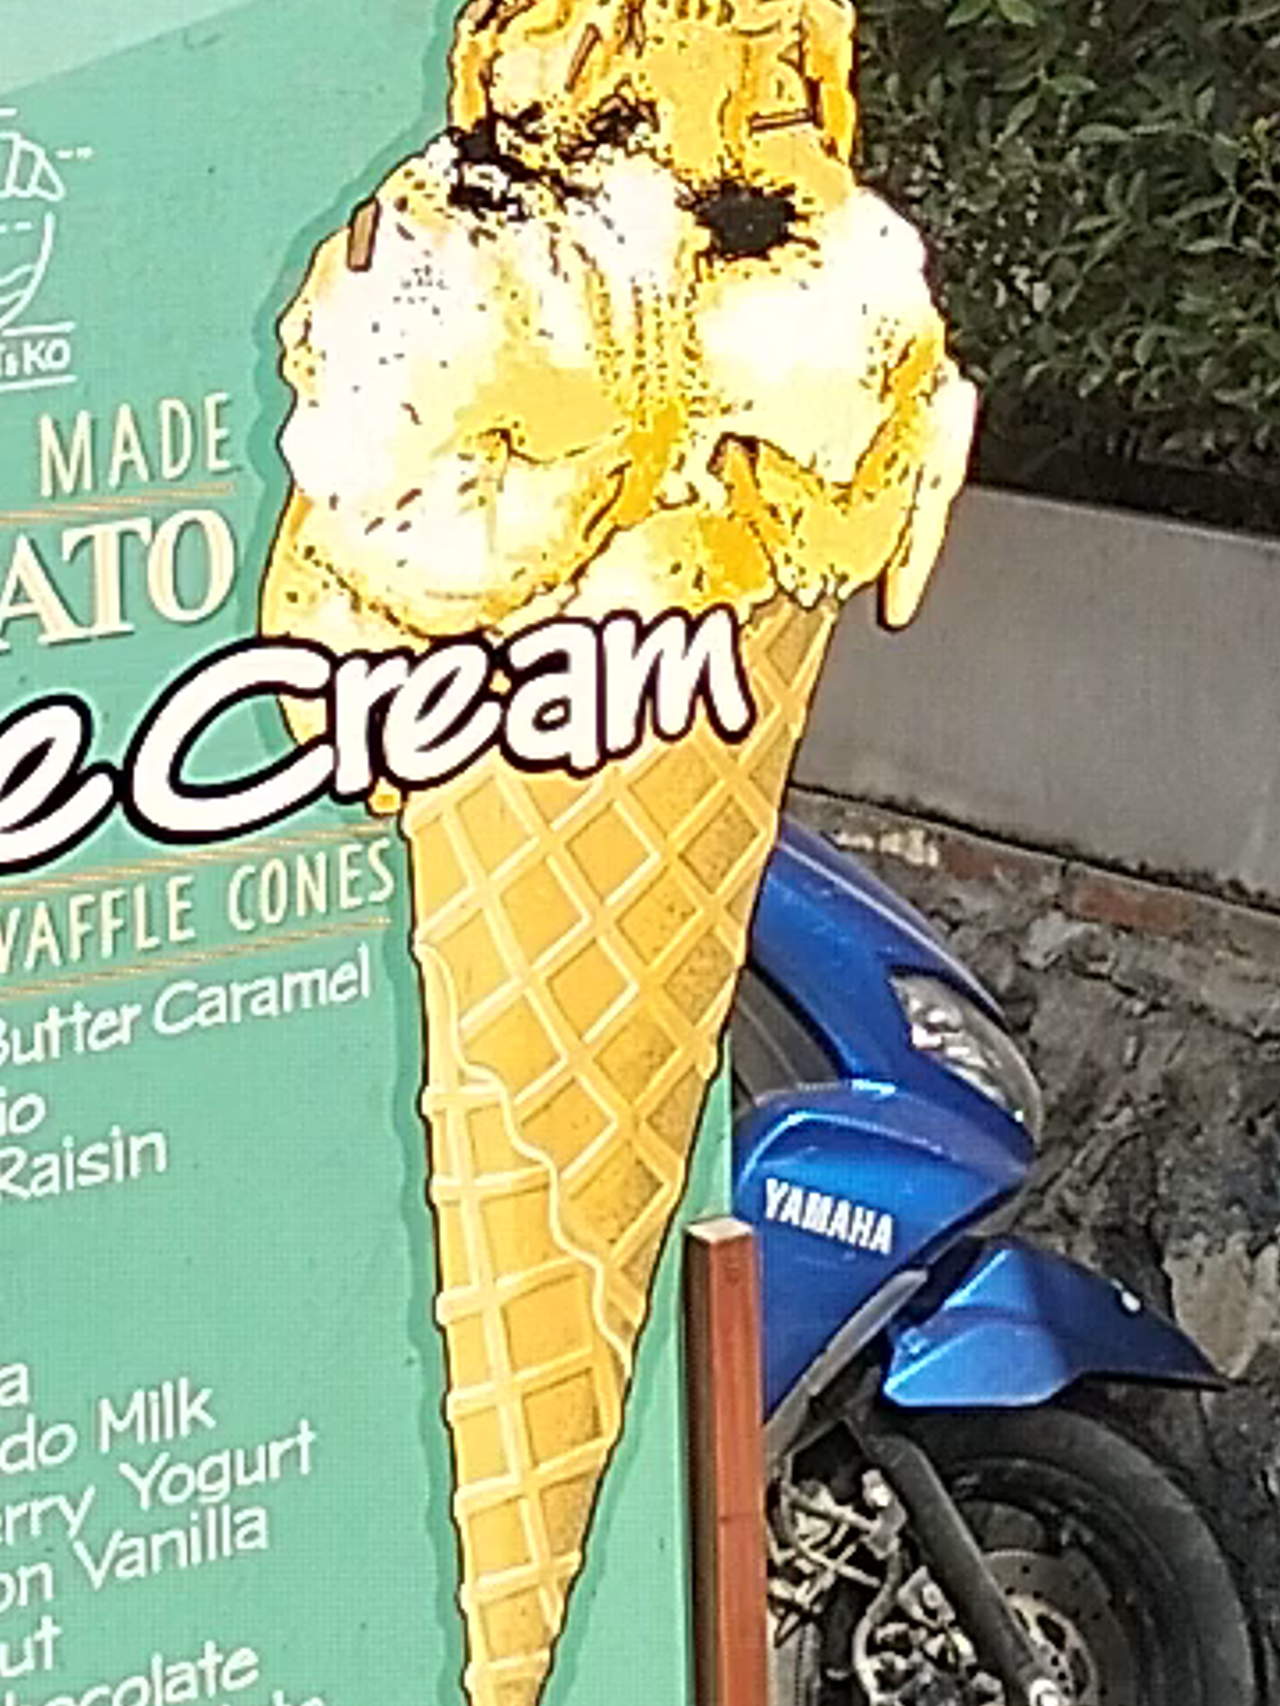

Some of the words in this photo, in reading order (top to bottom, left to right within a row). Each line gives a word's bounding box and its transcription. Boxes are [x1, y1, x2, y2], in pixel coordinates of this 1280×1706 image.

[39, 392, 233, 497] MADE
[124, 604, 756, 845] Cream
[228, 838, 397, 932] CONES
[153, 943, 372, 1041] Caramel
[764, 1178, 895, 1255] YAMAHA
[99, 1377, 216, 1452] Milk
[119, 1421, 317, 1518] Yogurt
[75, 1498, 270, 1591] Vanilla
